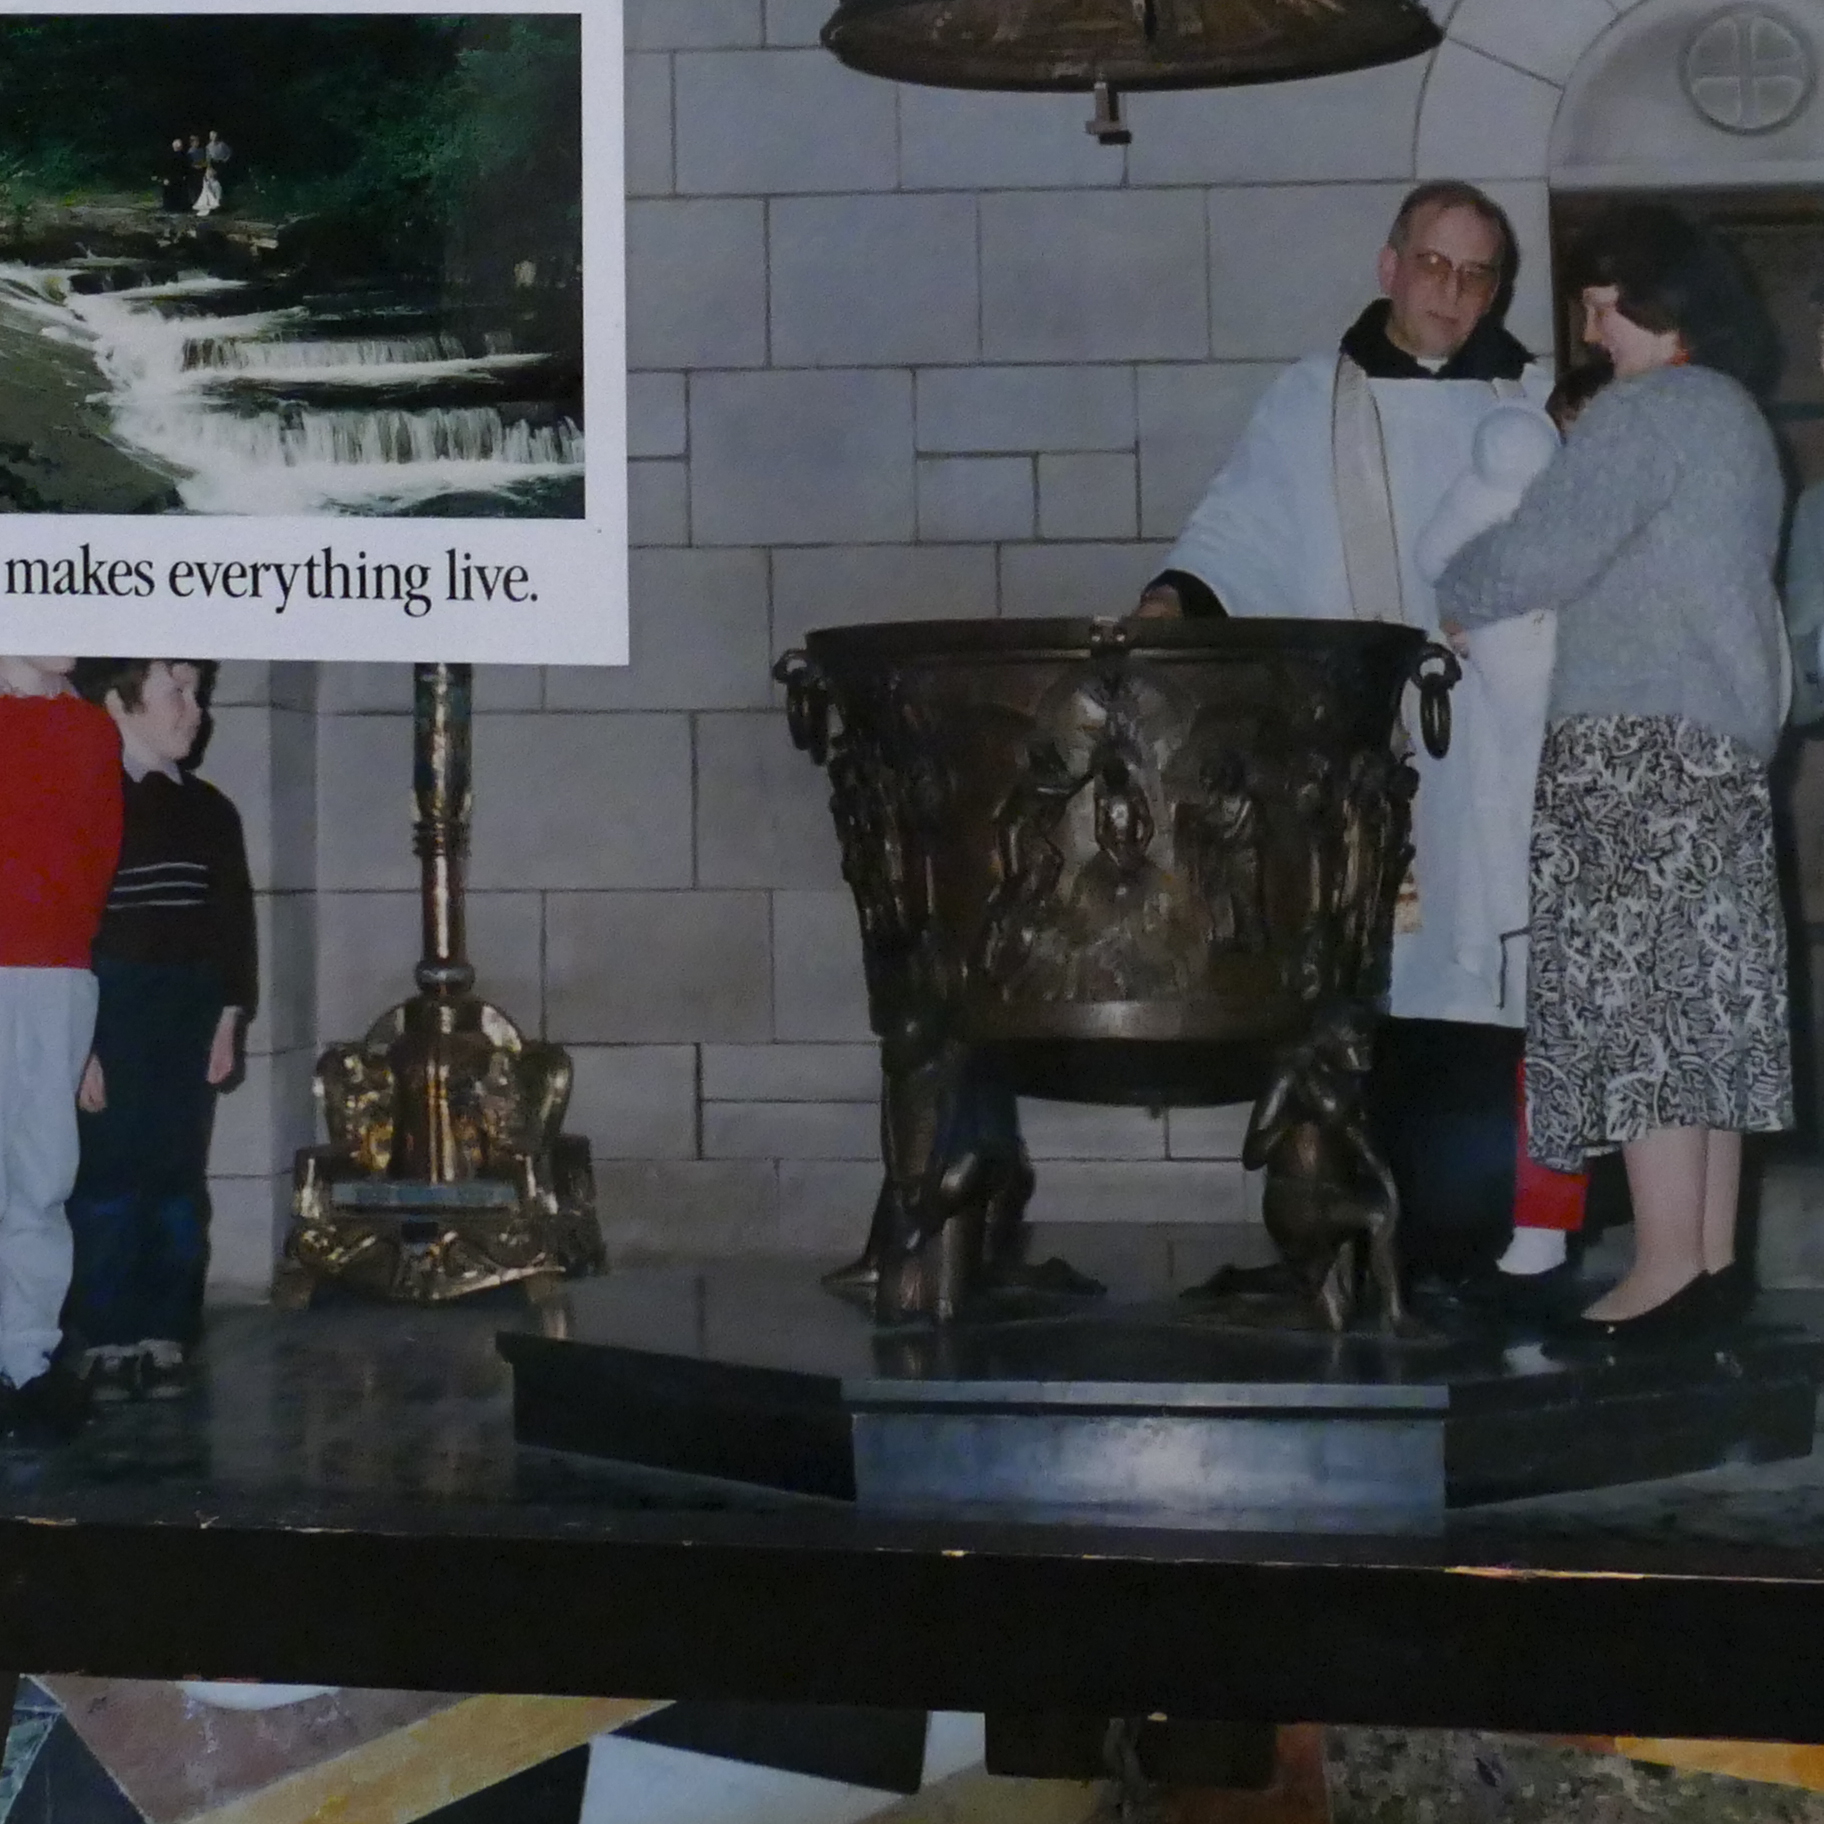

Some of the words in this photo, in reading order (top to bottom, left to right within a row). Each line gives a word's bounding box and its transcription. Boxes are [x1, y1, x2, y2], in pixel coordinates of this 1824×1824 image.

[5, 543, 155, 597] makes
[168, 546, 432, 618] everything
[446, 548, 538, 602] live.
